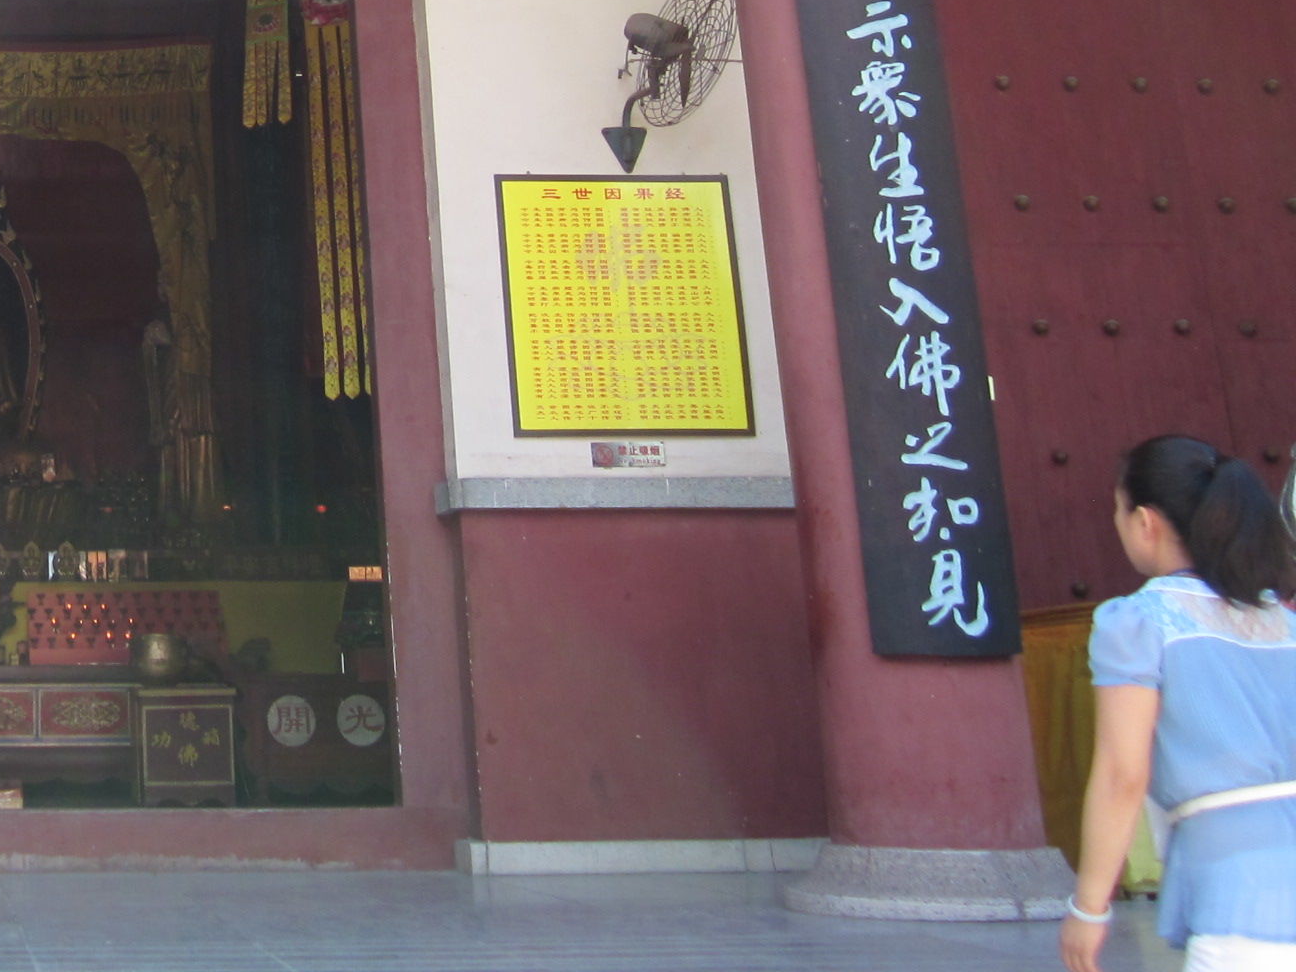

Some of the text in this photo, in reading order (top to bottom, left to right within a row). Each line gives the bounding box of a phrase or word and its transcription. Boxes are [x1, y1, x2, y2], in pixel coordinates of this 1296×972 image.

[541, 186, 687, 200] 三世因果经
[618, 445, 661, 456] 禁止吸烟
